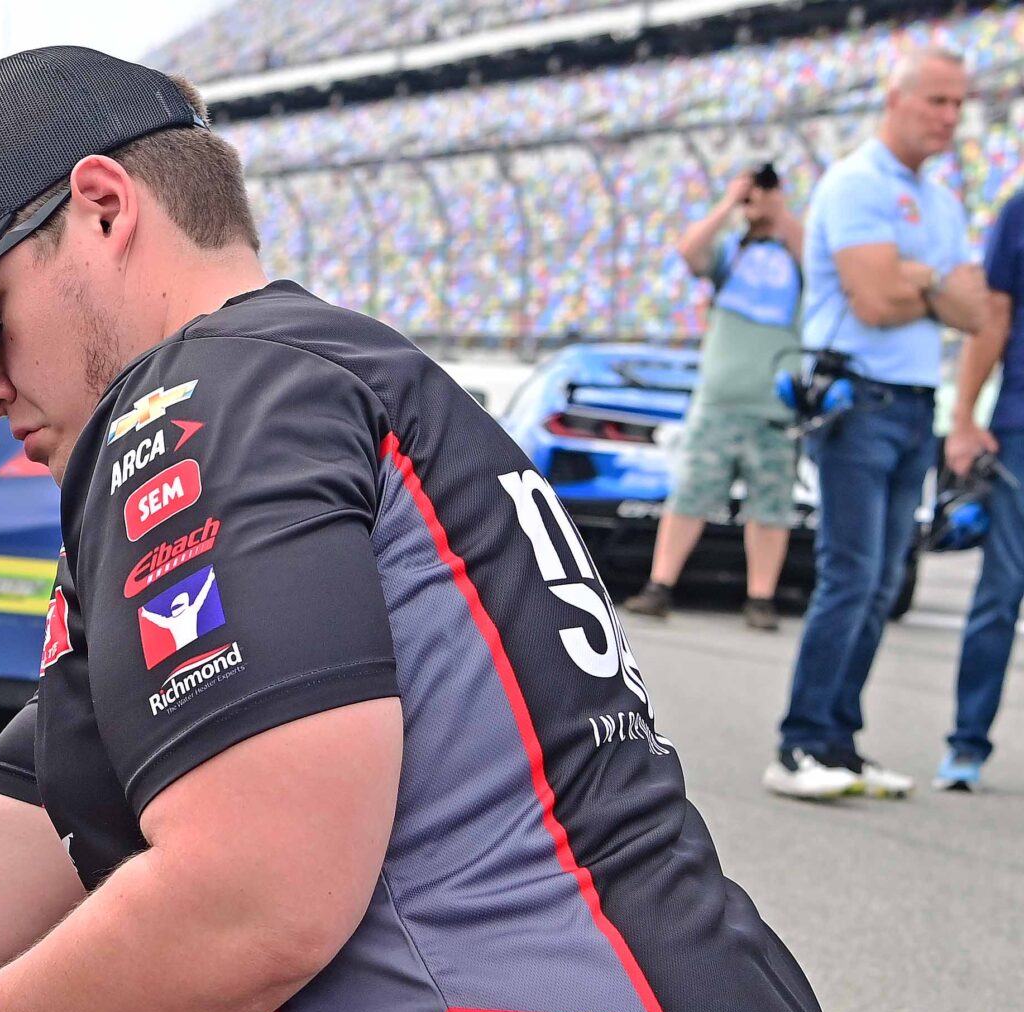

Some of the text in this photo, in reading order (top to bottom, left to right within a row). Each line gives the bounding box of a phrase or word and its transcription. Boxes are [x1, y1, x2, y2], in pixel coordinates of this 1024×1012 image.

[110, 430, 166, 496] ARCA
[138, 476, 185, 523] SEM
[125, 517, 222, 594] Eibach
[149, 641, 243, 716] Richmond
[176, 692, 194, 709] Water
[194, 679, 217, 697] Heater
[216, 665, 246, 683] Experts
